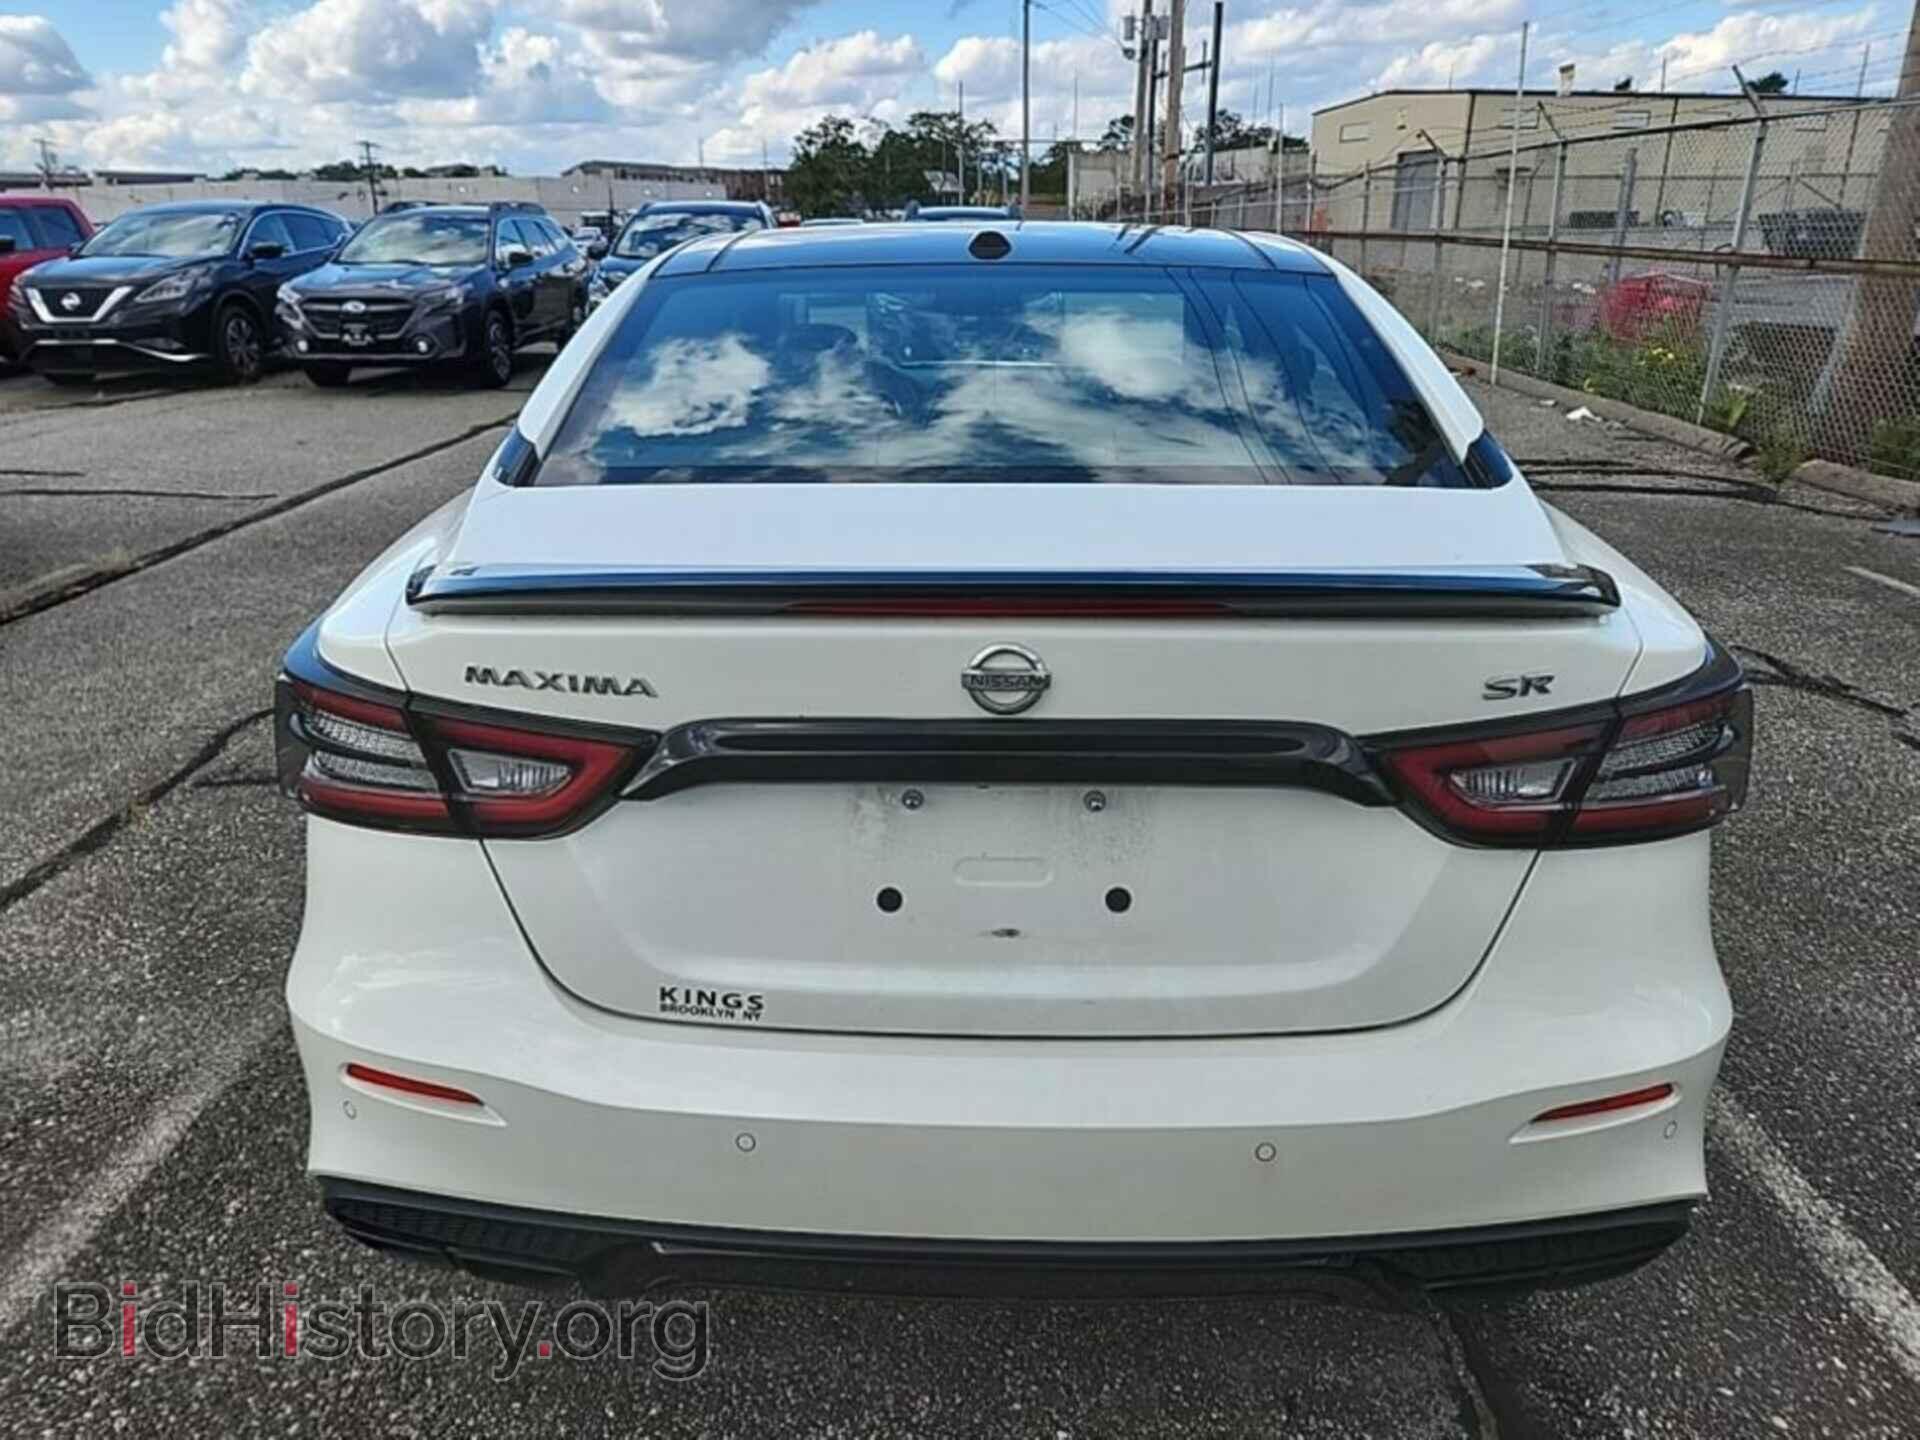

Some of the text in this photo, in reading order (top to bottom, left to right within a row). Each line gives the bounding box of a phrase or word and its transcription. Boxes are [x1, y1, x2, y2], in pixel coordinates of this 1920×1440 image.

[464, 665, 658, 698] MAXIMA
[969, 674, 1046, 689] NISSAN
[1482, 675, 1554, 700] SR
[660, 986, 764, 1010] KINGS
[660, 1003, 762, 1021] BROOKLYN NY
